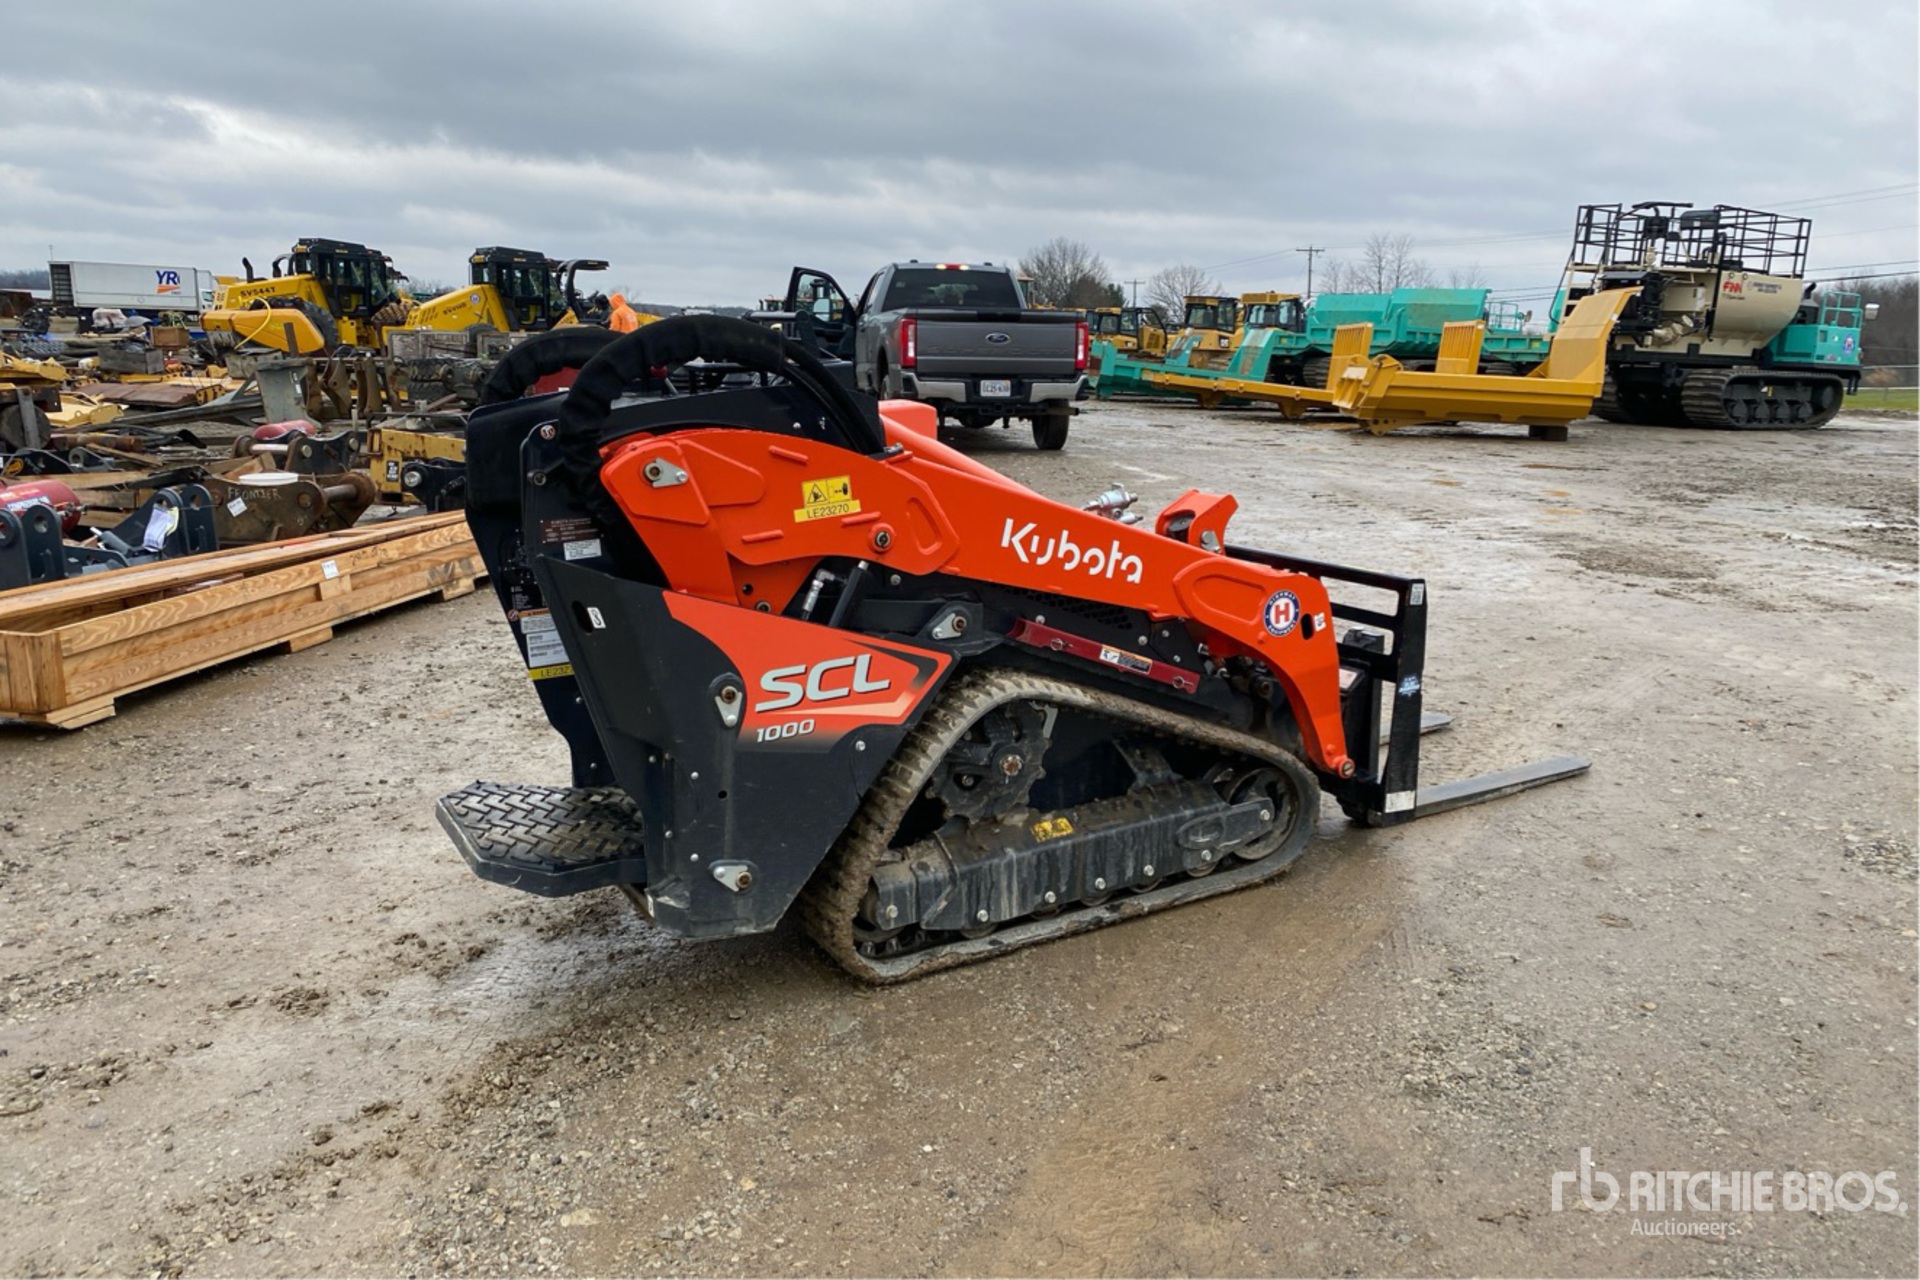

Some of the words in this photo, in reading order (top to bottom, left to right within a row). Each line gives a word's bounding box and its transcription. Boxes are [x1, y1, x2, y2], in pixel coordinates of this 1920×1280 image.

[806, 503, 850, 519] LE23270
[1001, 517, 1143, 584] Kubota
[755, 653, 891, 713] SCL
[757, 718, 815, 743] 1000
